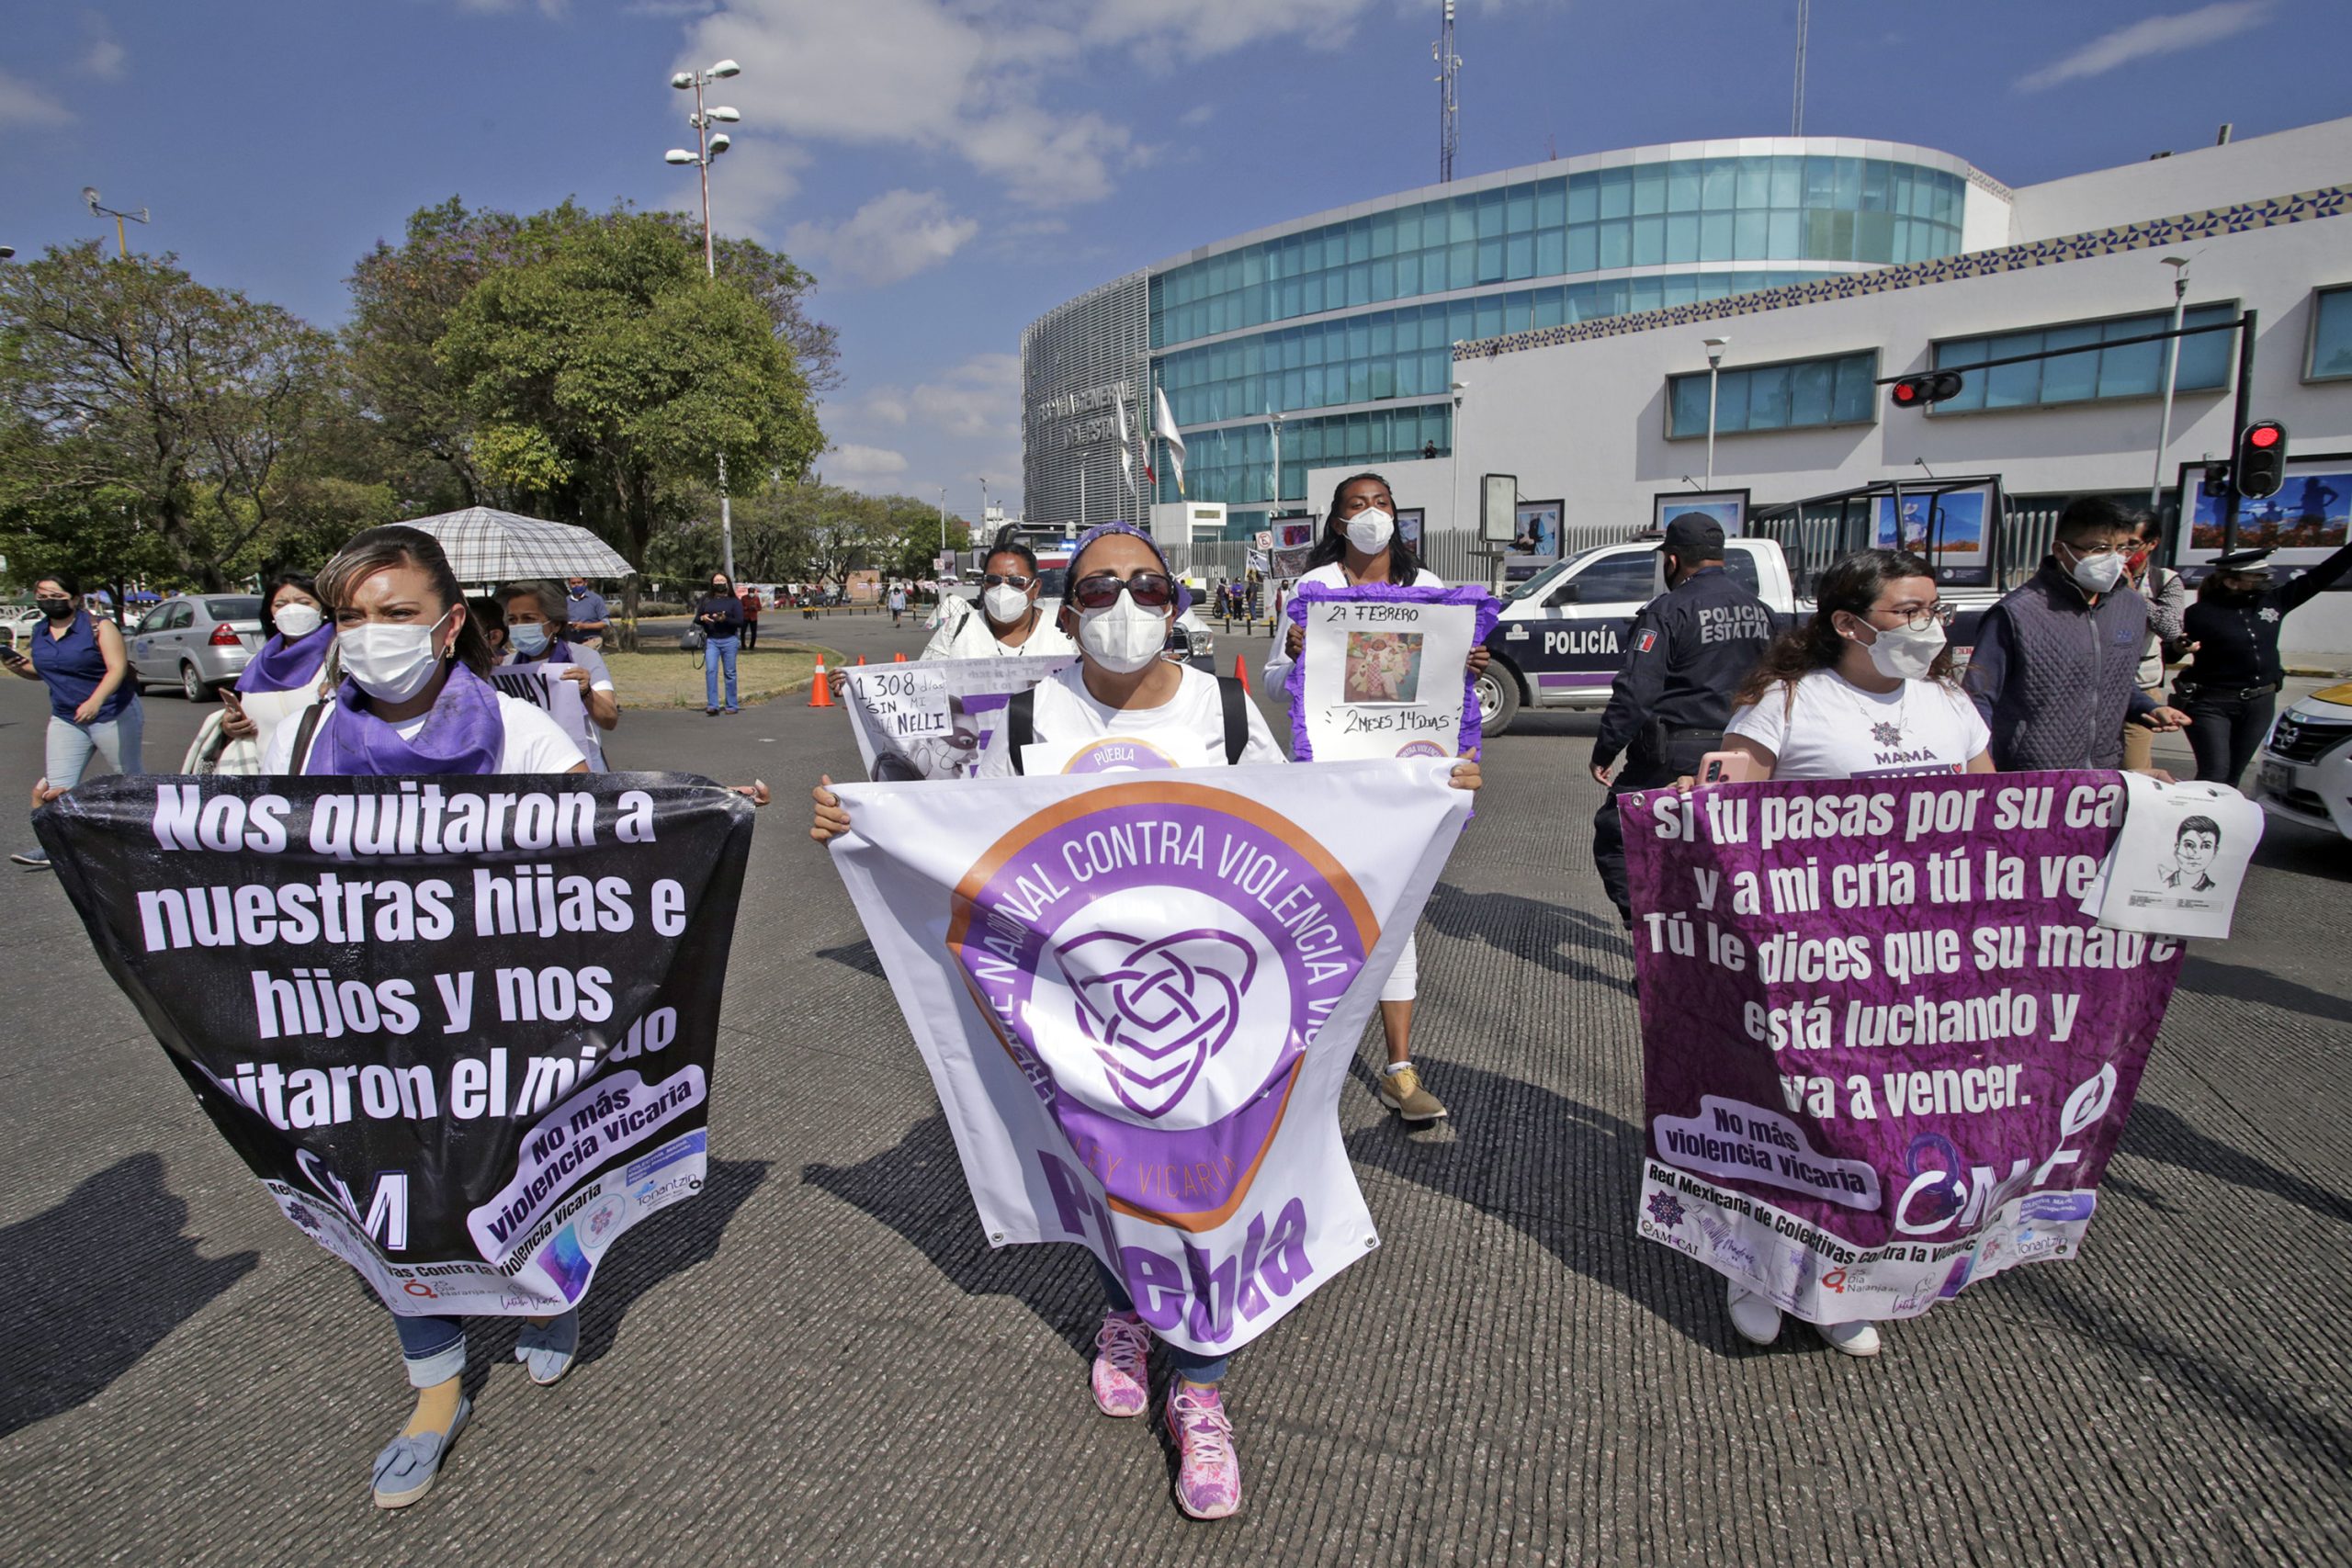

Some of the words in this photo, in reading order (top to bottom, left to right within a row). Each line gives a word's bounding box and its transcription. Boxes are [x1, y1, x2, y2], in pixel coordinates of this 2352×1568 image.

[1327, 605, 1347, 622] 27
[1355, 605, 1419, 622] FEBRERO
[1544, 625, 1619, 654] POLICÍA
[1701, 621, 1770, 644] ESTATAL
[856, 671, 915, 703] 1,308
[865, 700, 897, 715] SIN
[910, 696, 927, 709] MI
[897, 713, 945, 735] NELLI
[1093, 747, 1135, 766] PUEBLA
[1873, 746, 1939, 765] MAMÁ
[153, 784, 290, 856] Nos
[310, 782, 597, 861] quitaron
[616, 788, 657, 845] a
[1654, 790, 1695, 842] si
[1706, 792, 1748, 845] tu
[1760, 792, 1894, 851] pasas
[1905, 788, 1985, 842] por
[1995, 786, 2054, 830] su
[138, 872, 455, 953] nuestras
[473, 864, 636, 938] hijas
[651, 878, 686, 937] e
[1062, 821, 1204, 883] CONTRA
[1217, 833, 1349, 986] VIOLENCIA
[1695, 867, 1717, 909] y
[1734, 872, 1760, 915] a
[1769, 858, 1820, 914] mi
[1832, 850, 1916, 909] cría
[1928, 852, 1971, 901] tú
[1985, 849, 2025, 900] la
[2040, 854, 2105, 899] ve
[1644, 912, 1695, 956] Tú
[1709, 922, 1745, 971] le
[1758, 931, 1872, 985] dices
[1883, 931, 1962, 979] que
[1973, 926, 2027, 971] su
[252, 969, 421, 1039] hijos
[433, 971, 474, 1034] y
[496, 964, 613, 1023] nos
[1745, 997, 1832, 1052] está
[1845, 989, 2037, 1046] luchando
[2049, 993, 2080, 1043] y
[451, 1047, 507, 1120] el
[1781, 1073, 1836, 1119] va
[1848, 1073, 1877, 1121] a
[1883, 1064, 2031, 1118] vencer.
[531, 1125, 566, 1166] No
[570, 1088, 631, 1136] más
[1713, 1106, 1743, 1135] No
[1747, 1121, 1801, 1153] más
[487, 1134, 600, 1245] violencia
[603, 1080, 693, 1144] vicaria
[637, 1173, 697, 1206] Tonantzin
[1138, 1154, 1238, 1199] VICARIA
[1665, 1128, 1773, 1172] violencia
[1777, 1153, 1868, 1195] vicaria
[554, 1182, 603, 1227] Vicaria
[1649, 1163, 1676, 1189] Red
[1679, 1175, 1752, 1217] Mexicana
[1754, 1205, 1773, 1228] de
[1774, 1214, 1857, 1265] Colectivas
[1910, 1246, 1928, 1263] la
